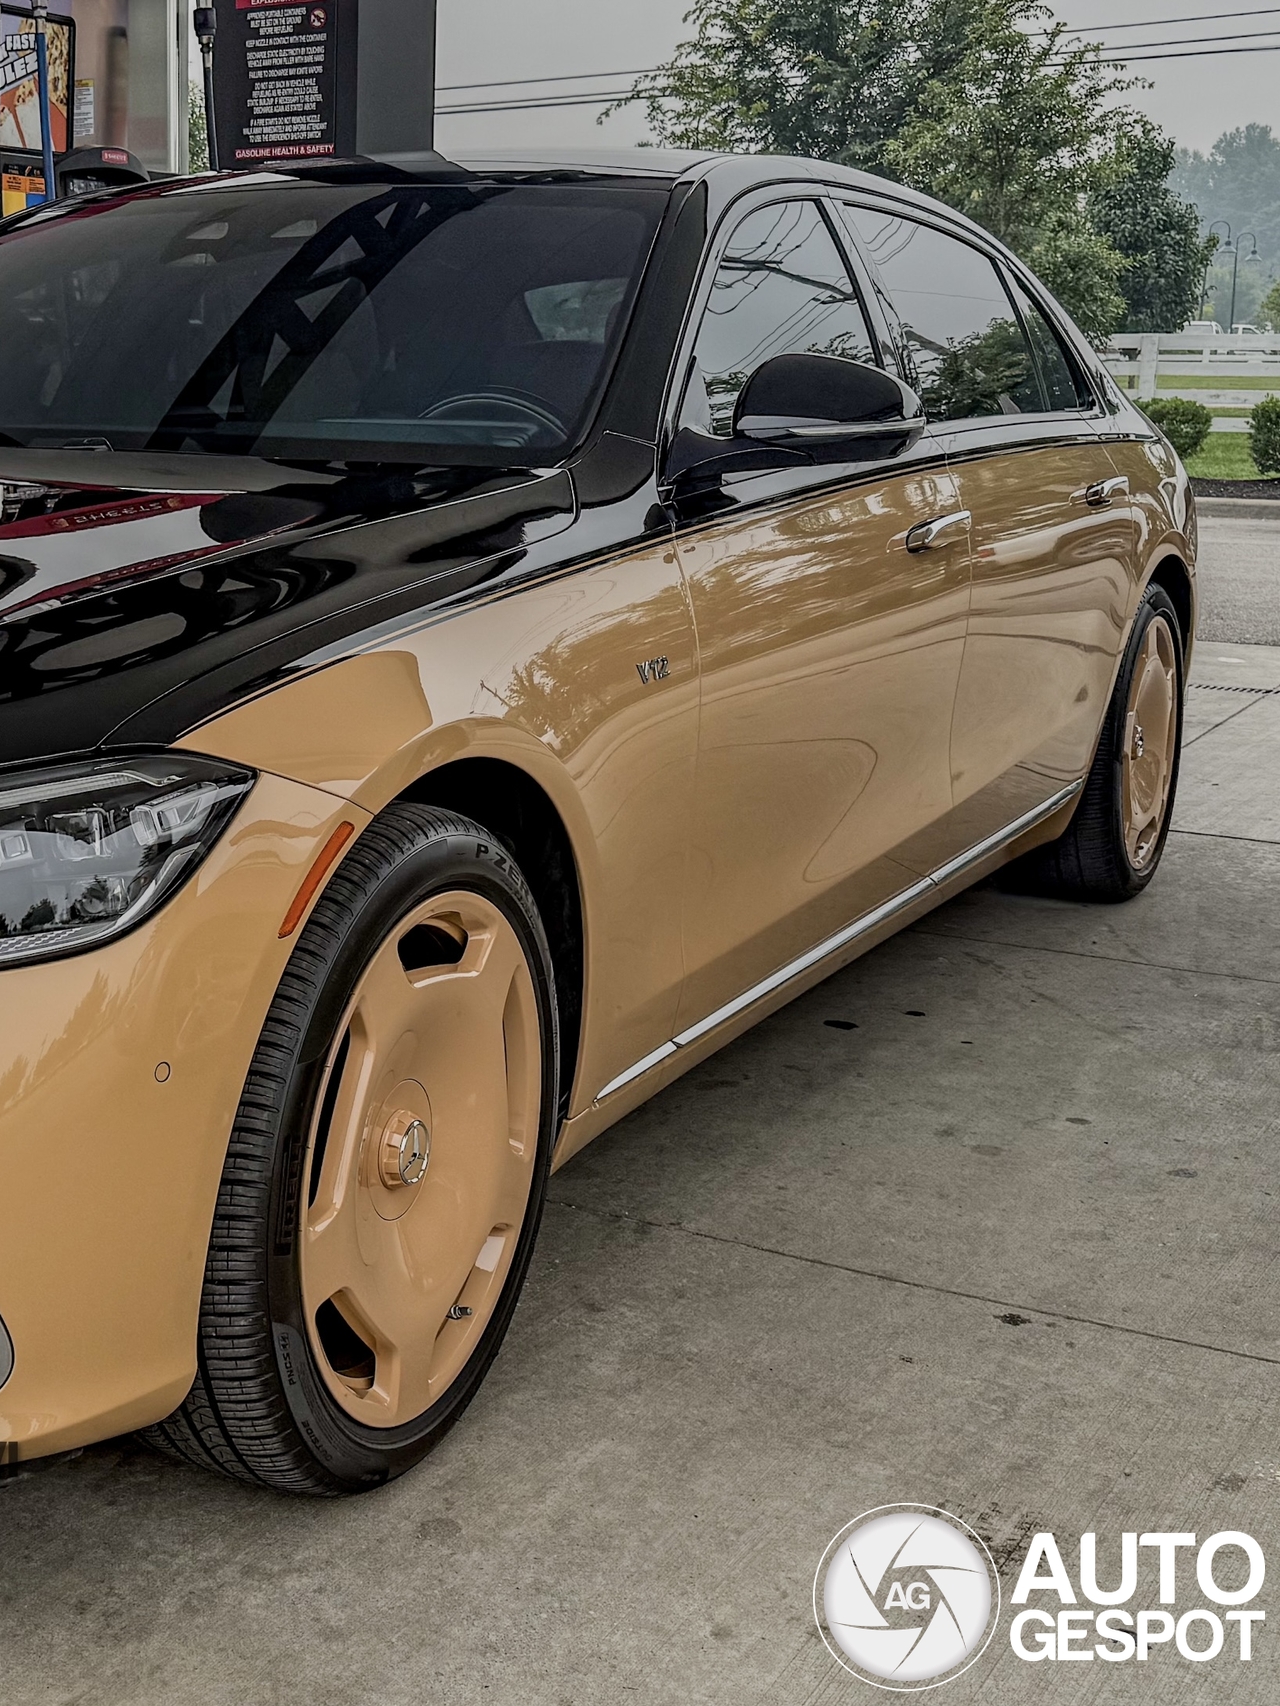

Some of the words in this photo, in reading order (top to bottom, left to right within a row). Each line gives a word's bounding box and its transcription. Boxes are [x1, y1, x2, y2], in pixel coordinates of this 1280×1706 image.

[5, 34, 36, 51] FAST
[236, 149, 270, 158] GASOLINE
[272, 147, 298, 156] HEALTH
[300, 146, 304, 154] &
[306, 144, 334, 153] SAFETY
[635, 655, 671, 685] V12
[475, 843, 489, 858] P
[282, 1352, 297, 1386] PNCS
[300, 1419, 333, 1462] OUTSIDE
